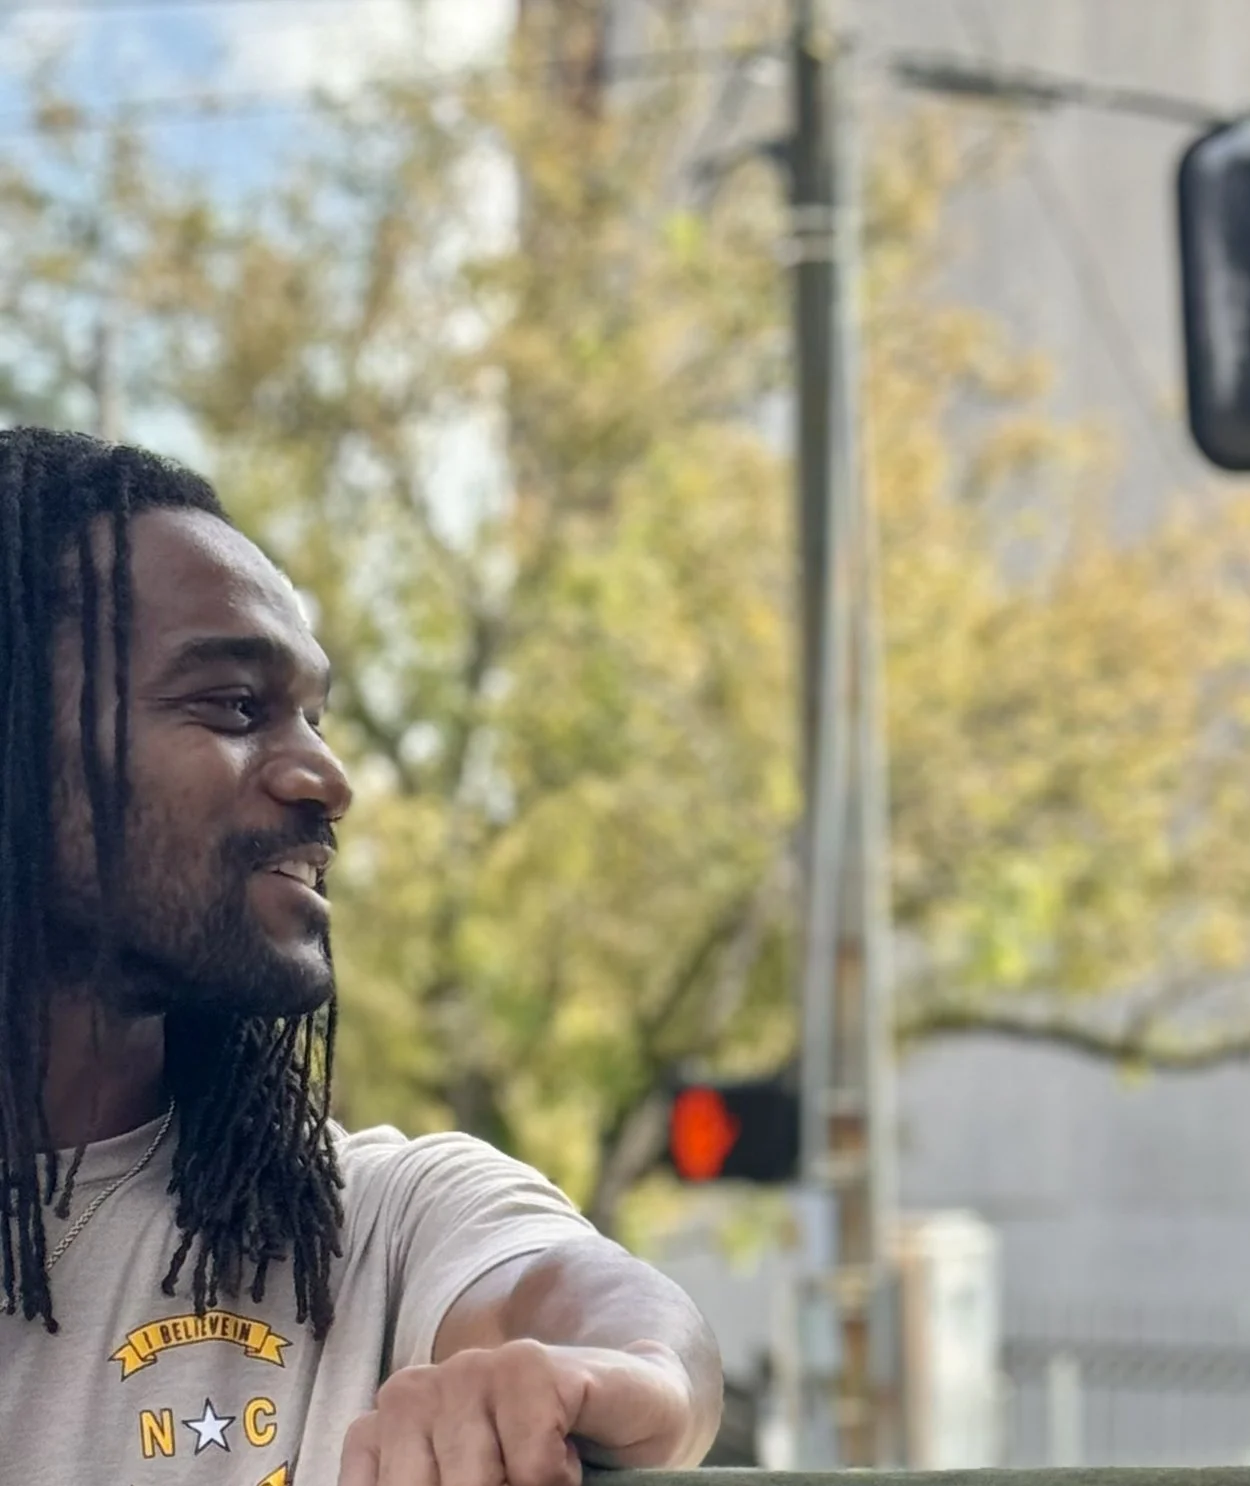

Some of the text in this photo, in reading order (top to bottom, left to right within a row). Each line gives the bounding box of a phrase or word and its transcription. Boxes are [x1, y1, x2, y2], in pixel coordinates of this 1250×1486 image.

[143, 1331, 153, 1349] I
[160, 1316, 229, 1344] BELIEVE
[140, 1397, 277, 1459] N C
